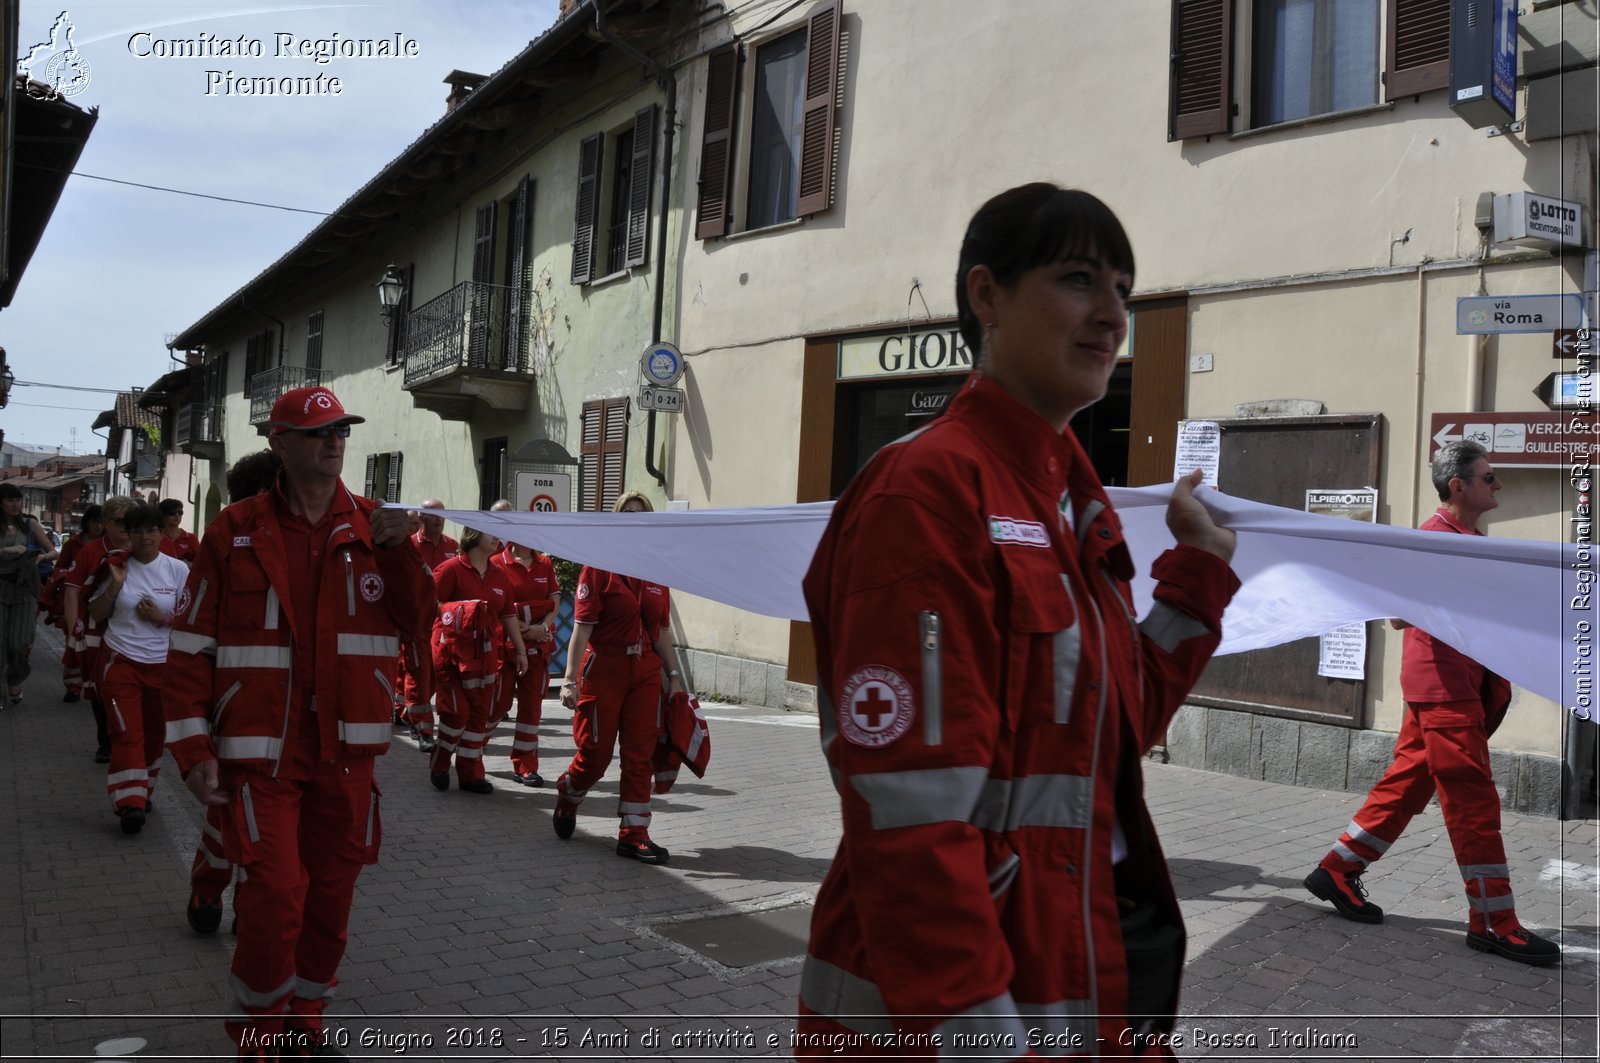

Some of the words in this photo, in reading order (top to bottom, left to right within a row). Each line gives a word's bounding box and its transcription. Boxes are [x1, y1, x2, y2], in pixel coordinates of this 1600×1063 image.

[1541, 203, 1576, 222] LOTTO
[1495, 300, 1511, 309] via
[1494, 312, 1543, 324] Roma
[1525, 442, 1588, 453] GUILLESTRE
[533, 479, 554, 487] zona
